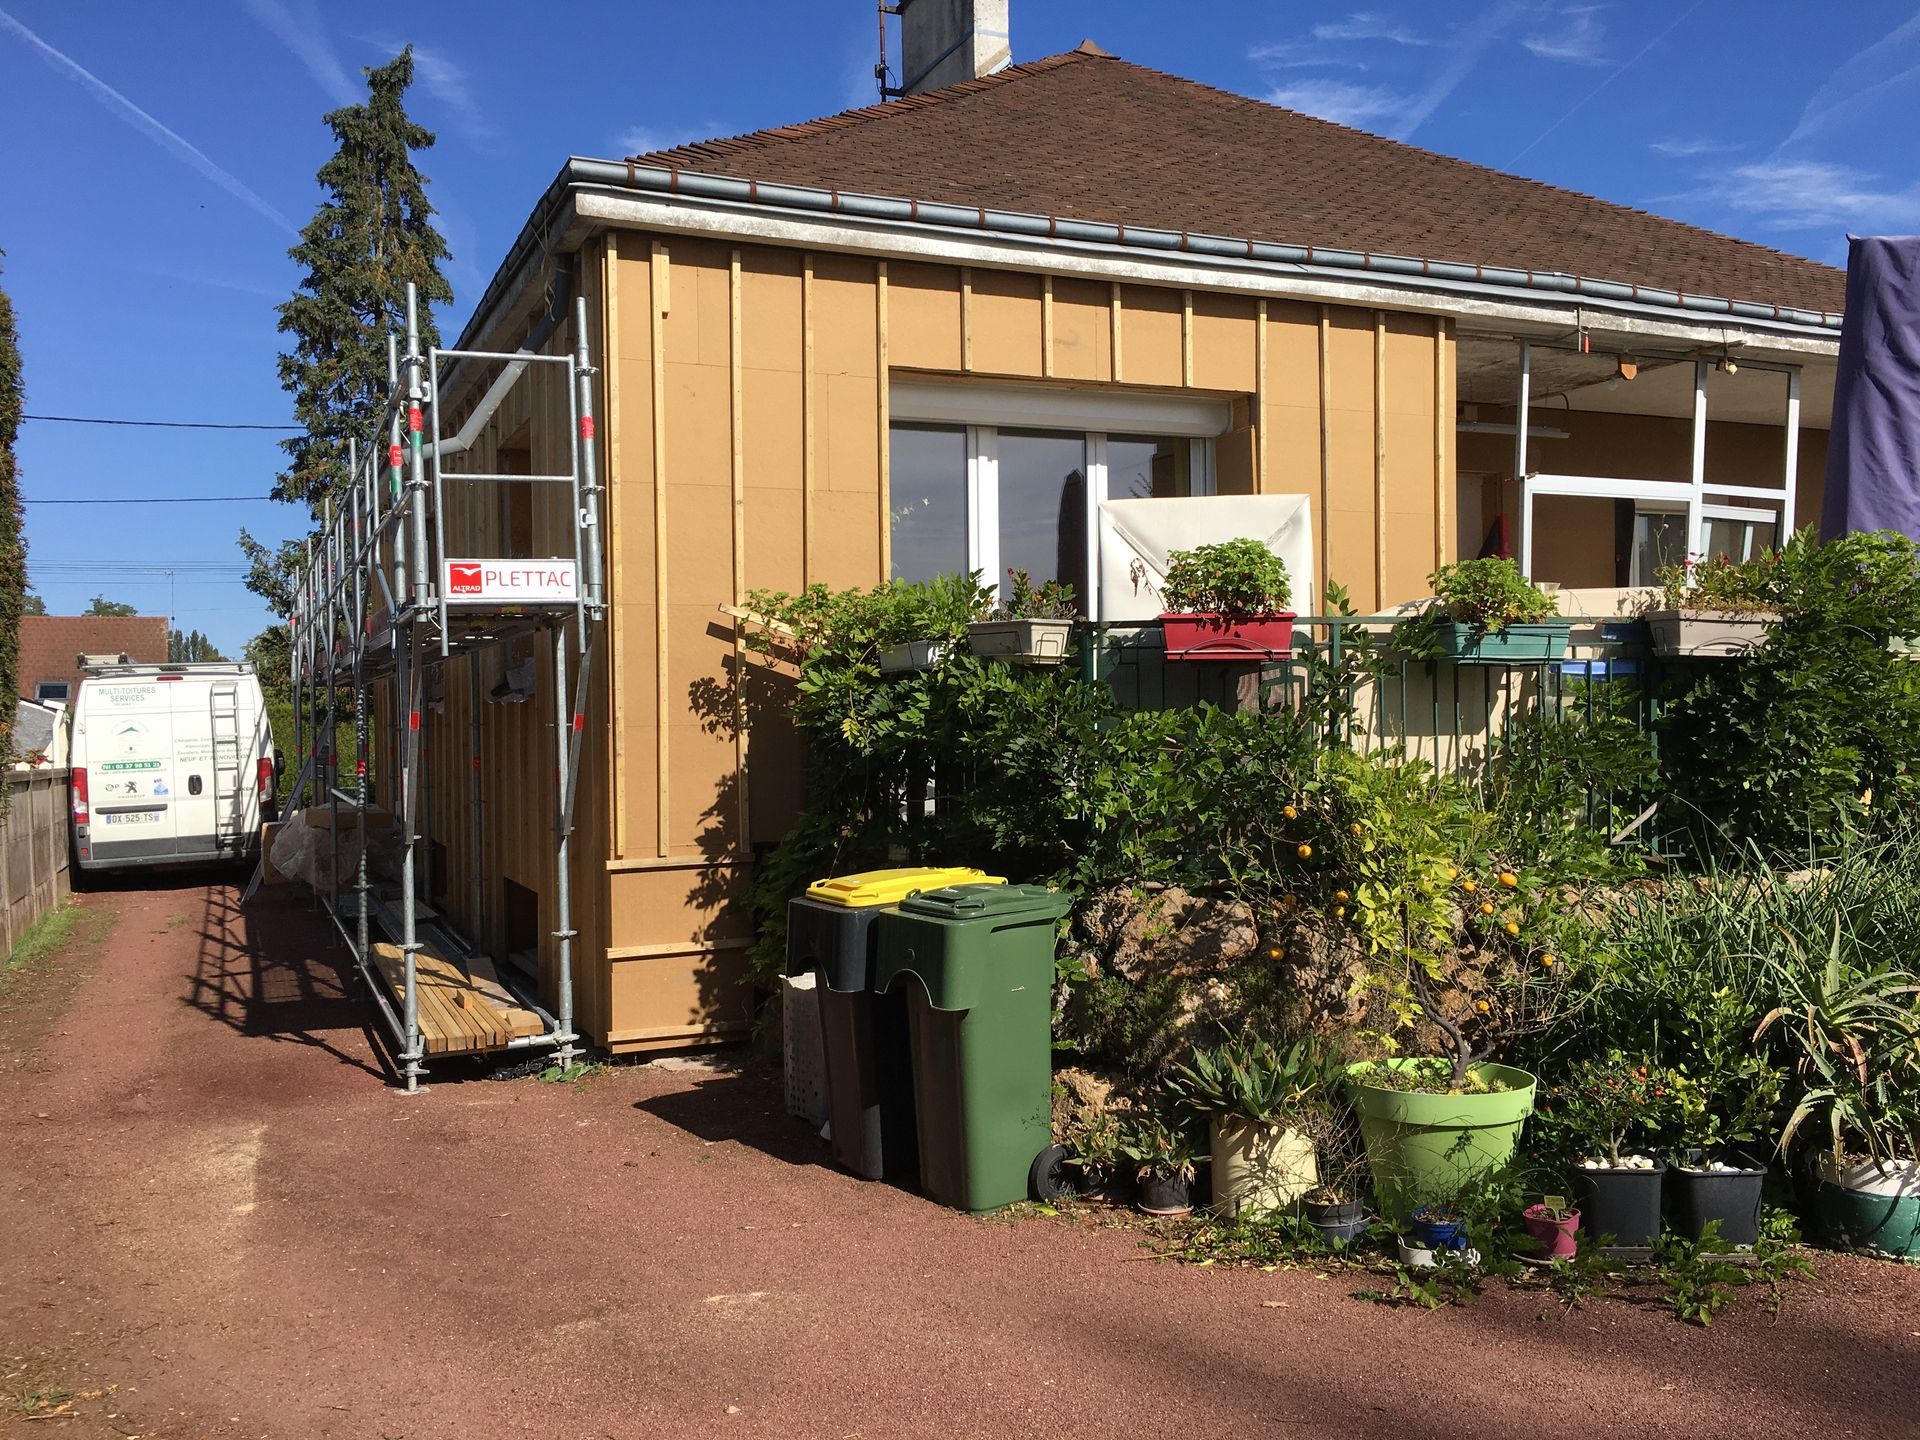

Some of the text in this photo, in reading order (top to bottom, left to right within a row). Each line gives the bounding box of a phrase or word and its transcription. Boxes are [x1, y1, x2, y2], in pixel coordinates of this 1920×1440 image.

[485, 570, 572, 587] PLETTAC
[452, 585, 481, 593] ALTRAD
[110, 694, 145, 703] SERVICES
